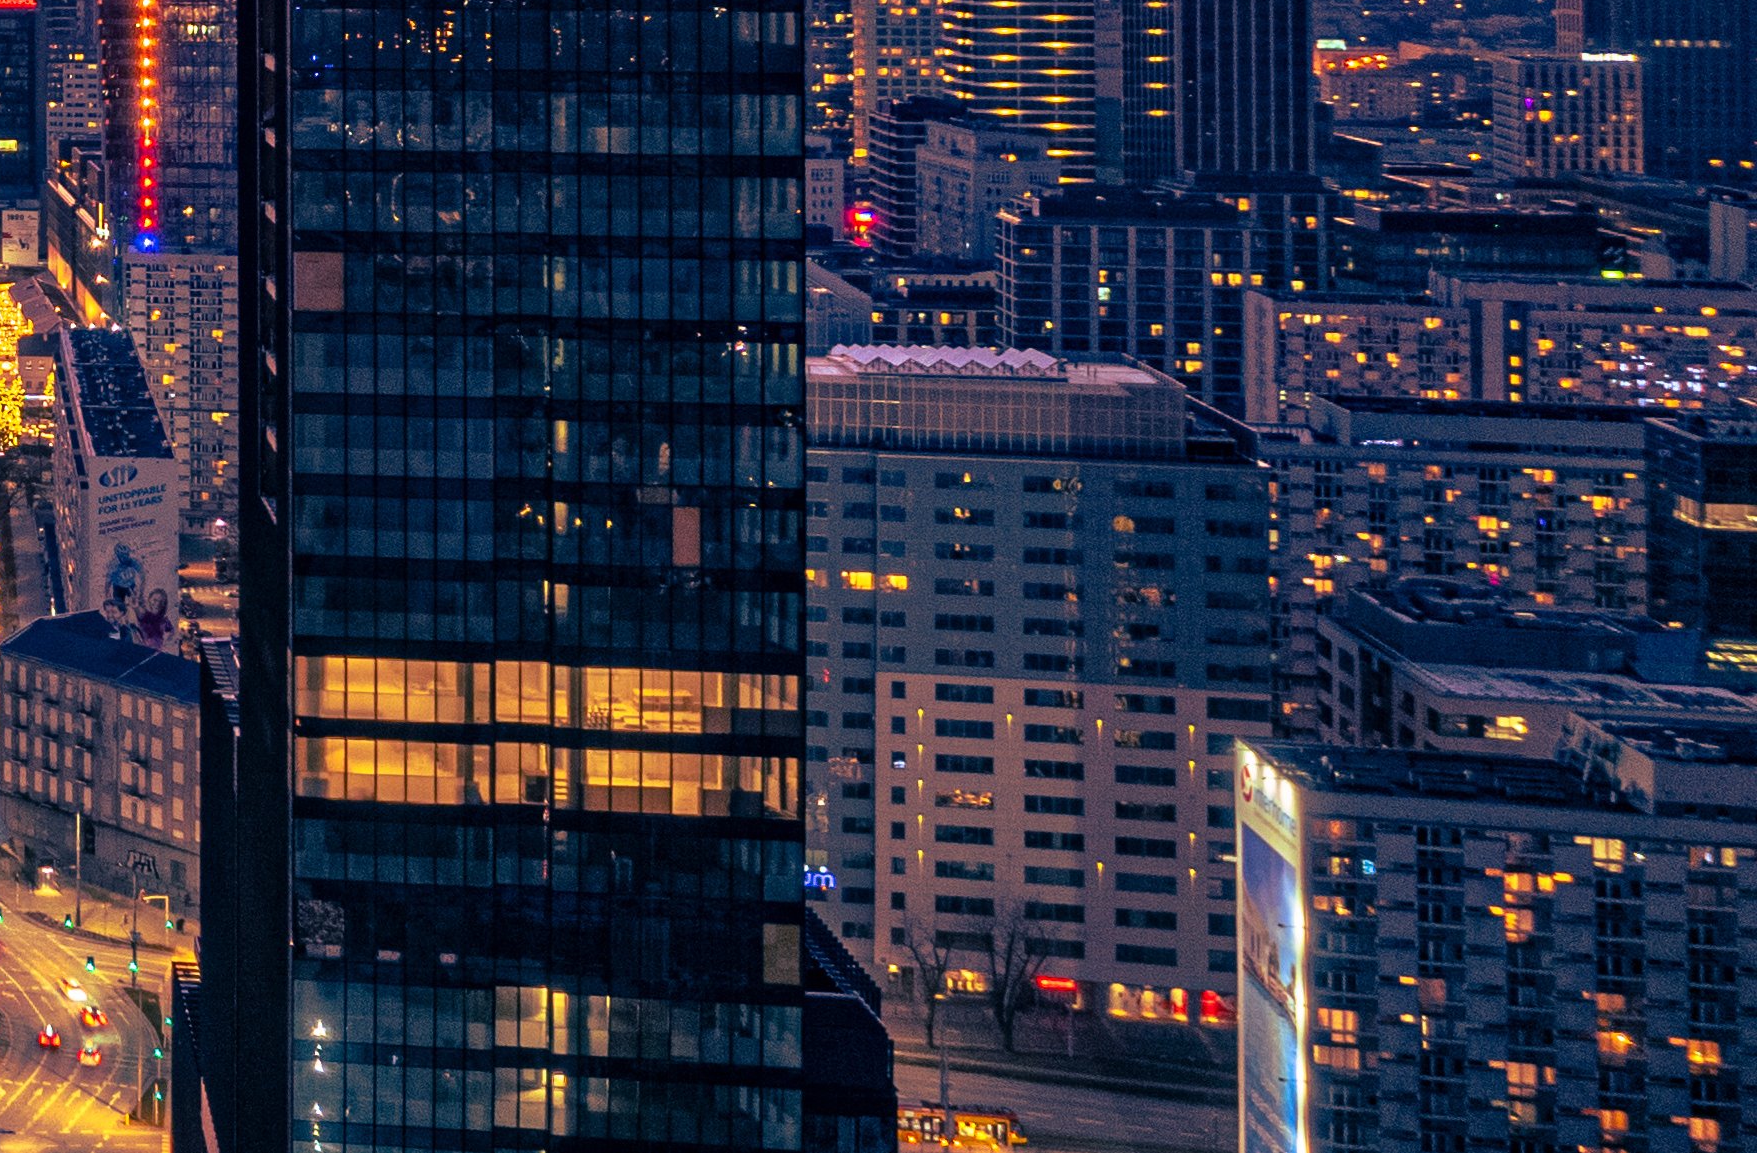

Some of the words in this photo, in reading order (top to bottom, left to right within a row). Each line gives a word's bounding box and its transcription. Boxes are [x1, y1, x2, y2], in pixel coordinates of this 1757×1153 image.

[98, 483, 167, 504] UNSTOPPABLE
[98, 504, 118, 515] FOR
[120, 501, 131, 510] 15
[132, 494, 164, 508] YEARS
